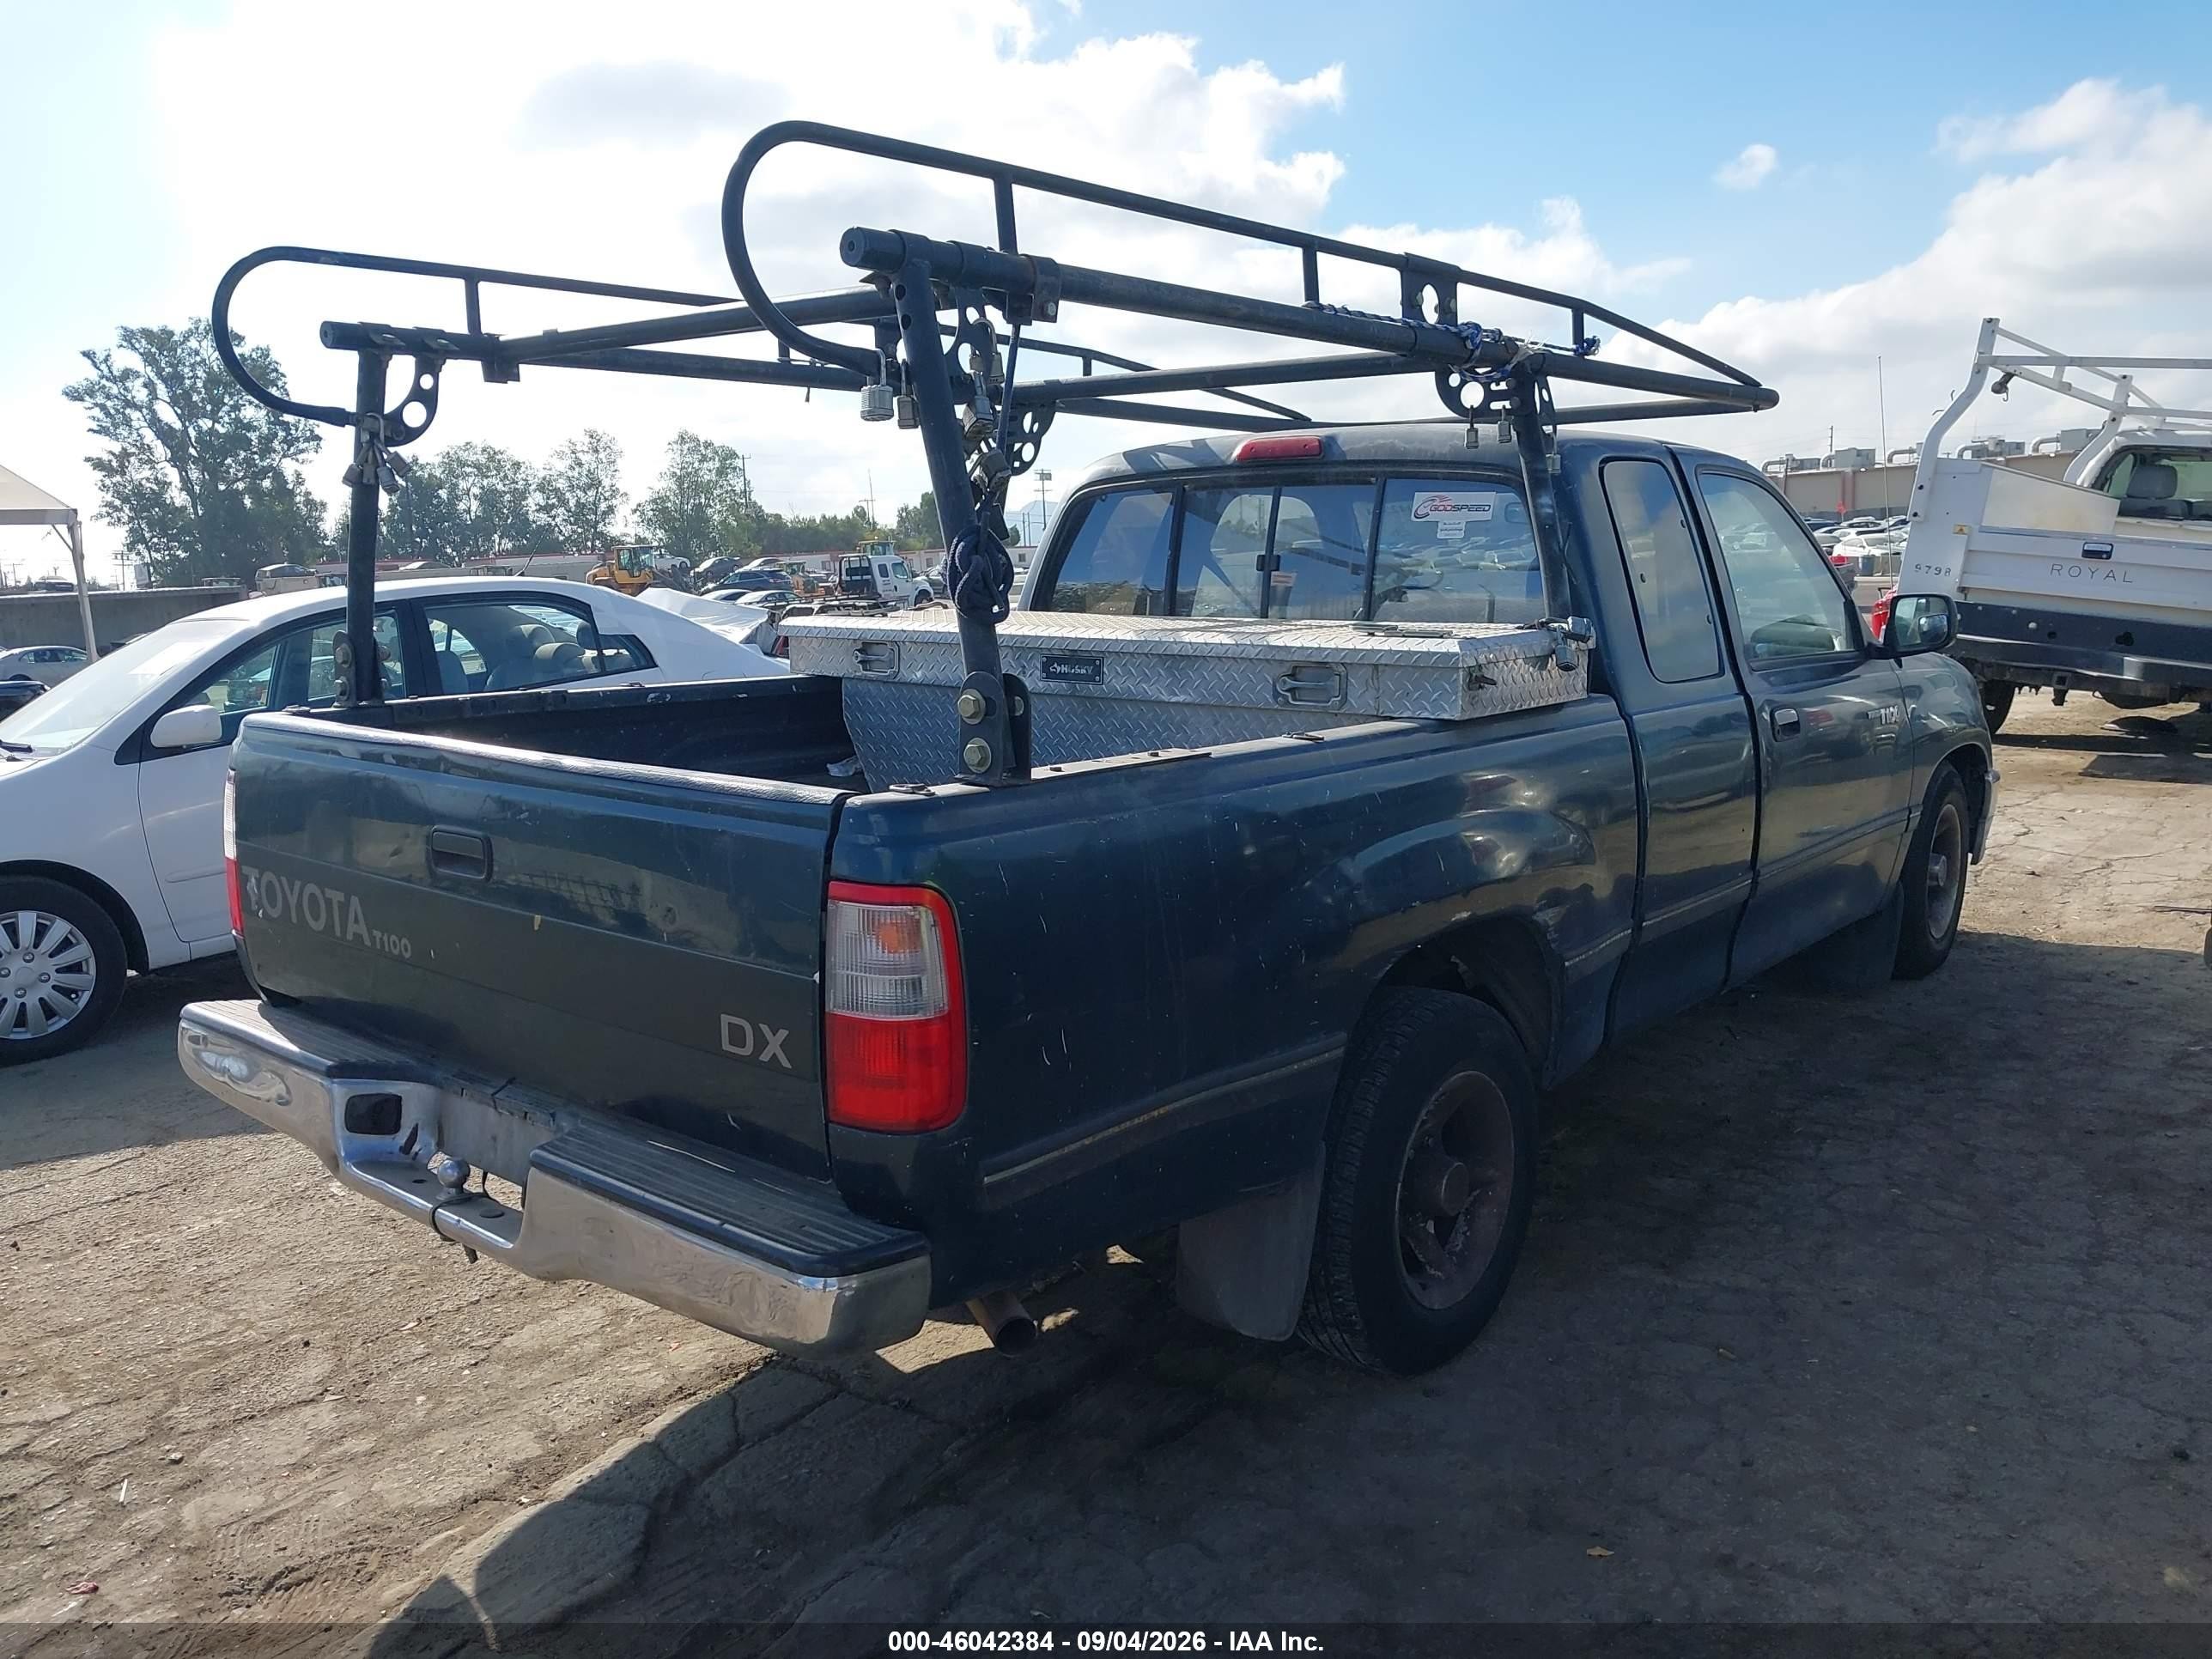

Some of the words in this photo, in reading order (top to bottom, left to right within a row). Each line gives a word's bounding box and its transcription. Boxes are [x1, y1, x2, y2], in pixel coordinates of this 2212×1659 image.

[1429, 504, 1492, 513] GODSPEED
[2050, 563, 2134, 585] ROYAL
[241, 865, 372, 947] TOYOTA
[372, 929, 411, 959] T100
[720, 1013, 793, 1069] DX
